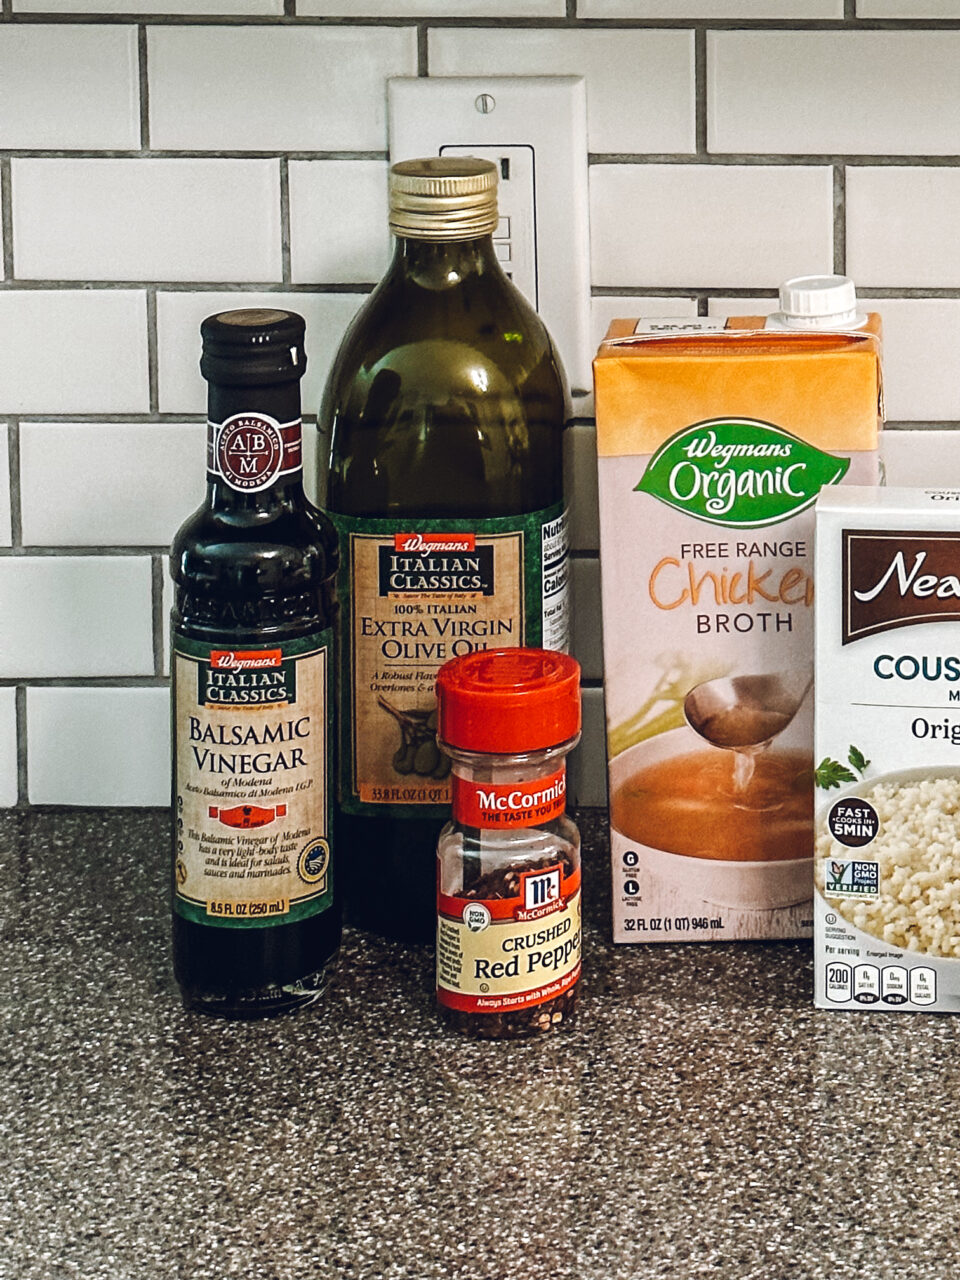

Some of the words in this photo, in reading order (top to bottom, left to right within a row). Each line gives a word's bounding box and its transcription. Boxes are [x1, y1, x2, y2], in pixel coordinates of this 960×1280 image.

[682, 431, 792, 468] Wegmans
[669, 461, 806, 514] Organic
[401, 534, 469, 558] Wegmans
[681, 543, 729, 559] FREE
[736, 541, 807, 558] RANGE
[390, 555, 480, 572] ITALIAN
[389, 573, 482, 589] CLASSICS
[394, 604, 424, 615] 100%
[427, 604, 477, 614] ITALIAN
[361, 617, 428, 637] EXTRA
[432, 617, 512, 637] VIRGIN
[696, 613, 793, 634] BROTH
[381, 639, 446, 660] OLIVE
[217, 652, 277, 674] Wegmans
[206, 670, 287, 687] ITALIAN
[381, 671, 413, 680] Robust
[206, 686, 287, 702] CLASSICS
[189, 715, 311, 745] BALSAMIC
[191, 745, 308, 774] VINEGAR
[220, 777, 232, 789] of
[233, 777, 273, 788] Modena
[481, 812, 500, 822] THE
[503, 810, 532, 822] TASTE
[535, 805, 552, 816] YOU
[837, 807, 870, 818] FAST
[834, 823, 873, 837] 5MIN
[854, 863, 877, 872] NON
[854, 871, 877, 879] GMO
[828, 883, 877, 893] VERIFIED
[210, 902, 223, 914] 8.5
[224, 903, 234, 915] FL
[236, 904, 247, 915] OZ
[248, 902, 268, 915] (250
[269, 899, 285, 913] mL)
[469, 910, 485, 918] NON
[517, 899, 565, 920] McCormick
[469, 916, 485, 924] GMO
[624, 918, 636, 931] 32
[637, 919, 648, 931] FL
[649, 918, 662, 931] OZ
[664, 917, 673, 932] (1
[674, 917, 690, 932] QT)
[691, 917, 709, 930] 946
[710, 916, 725, 930] mL
[502, 917, 571, 952] CRUSHED
[474, 955, 519, 979] Red
[527, 931, 579, 974] Peppe
[825, 945, 836, 953] Per
[838, 947, 860, 957] serving
[829, 968, 849, 983] 200
[477, 998, 502, 1008] Always
[502, 996, 525, 1006] Starts
